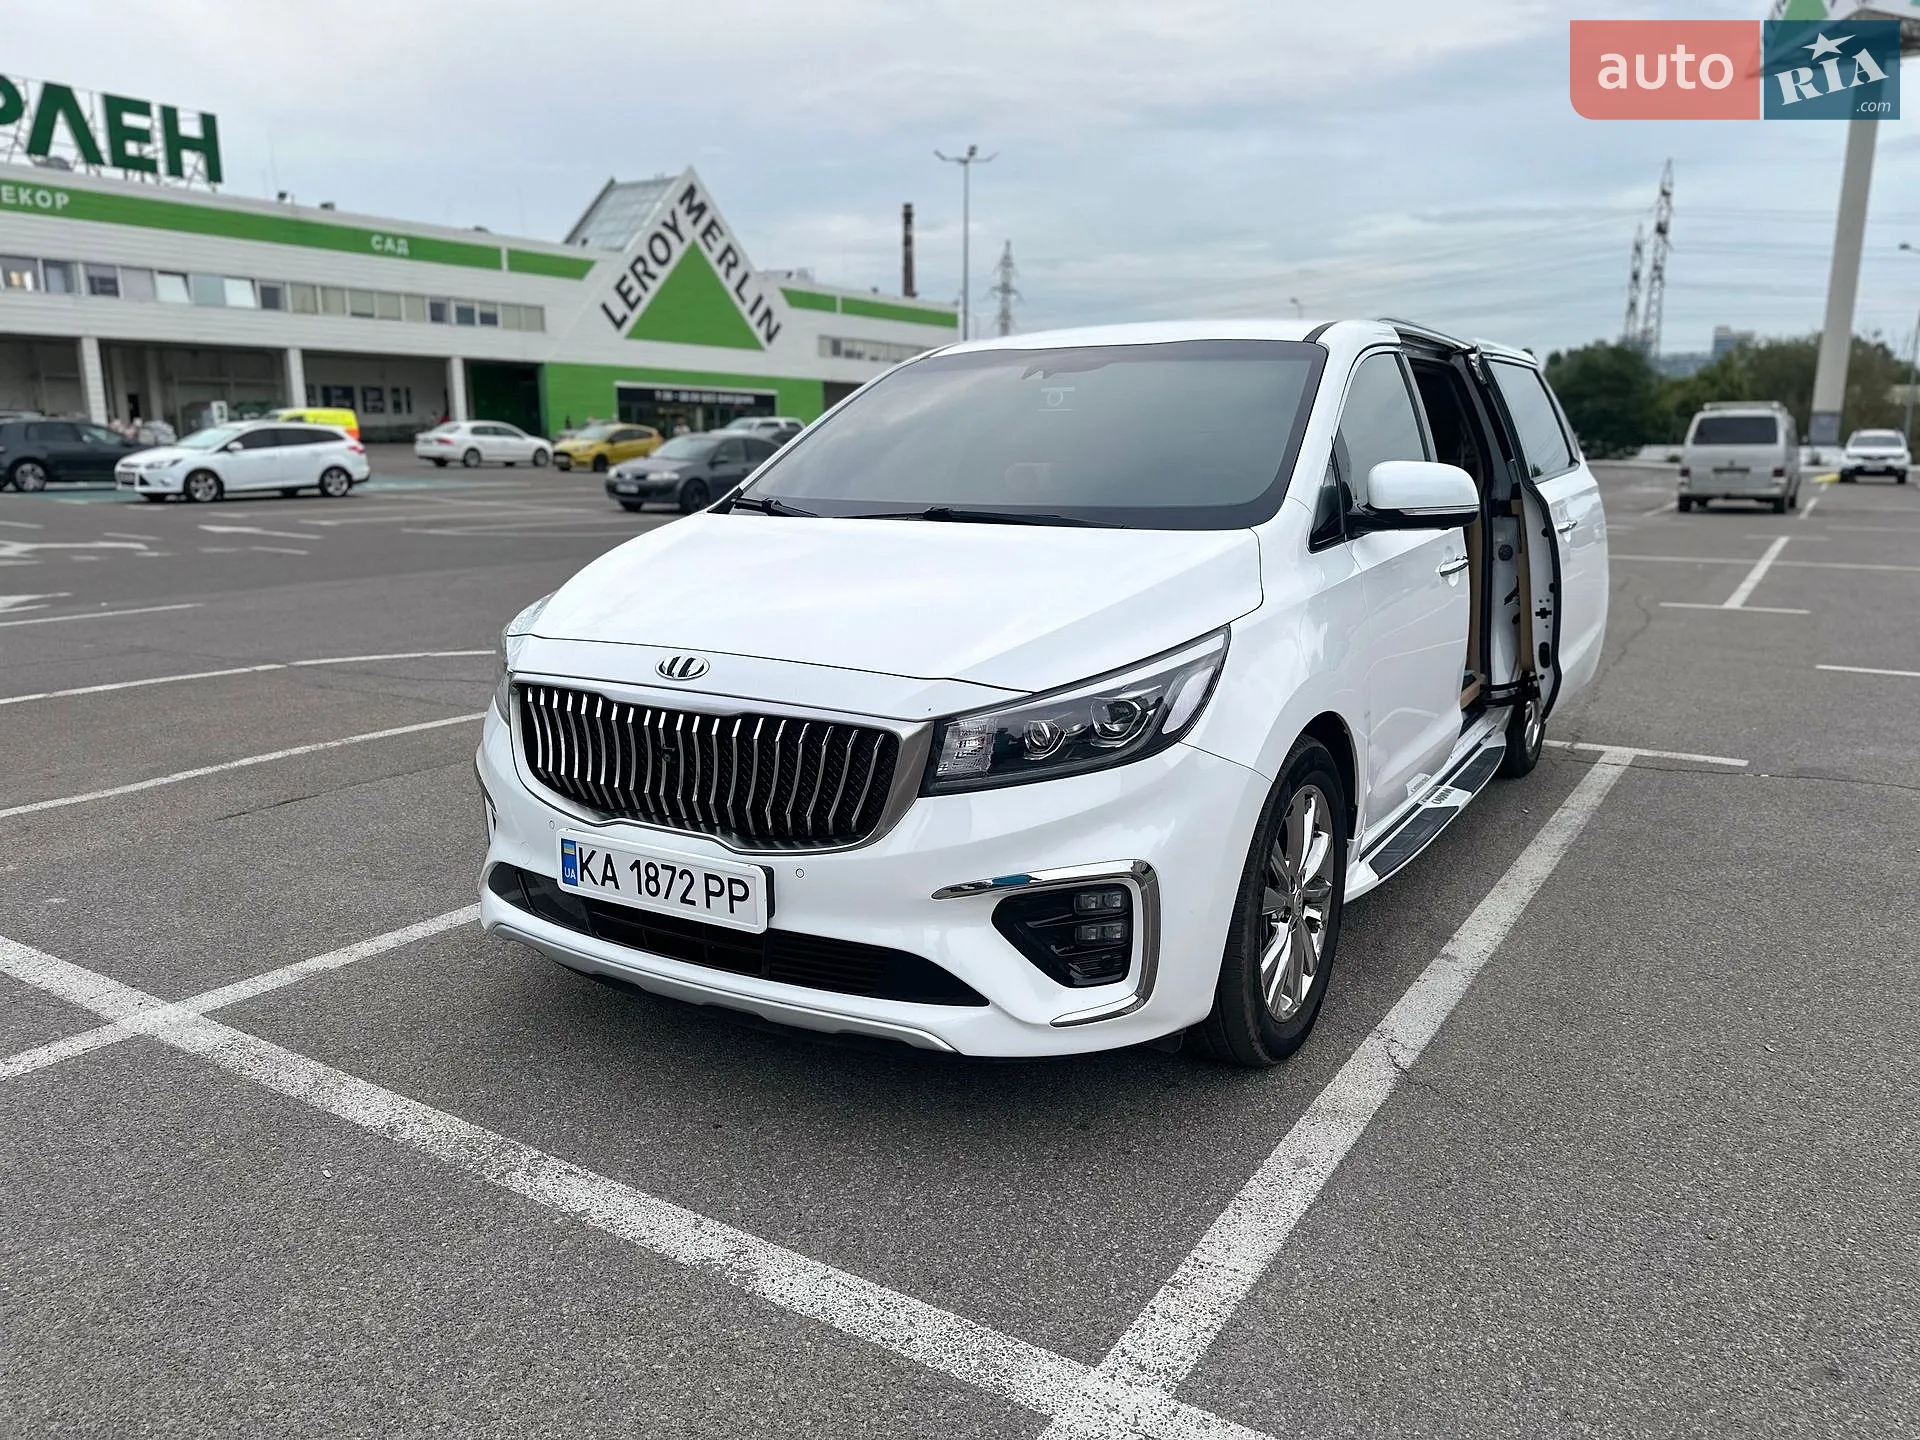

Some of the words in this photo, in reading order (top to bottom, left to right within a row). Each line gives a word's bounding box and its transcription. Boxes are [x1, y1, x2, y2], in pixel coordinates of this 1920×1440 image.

[370, 233, 410, 257] САД
[599, 208, 685, 332] LEROY
[678, 183, 782, 345] MERLIN
[564, 866, 577, 880] UA
[578, 846, 620, 890] KA
[629, 859, 697, 907] 1872
[704, 872, 750, 914] PP
